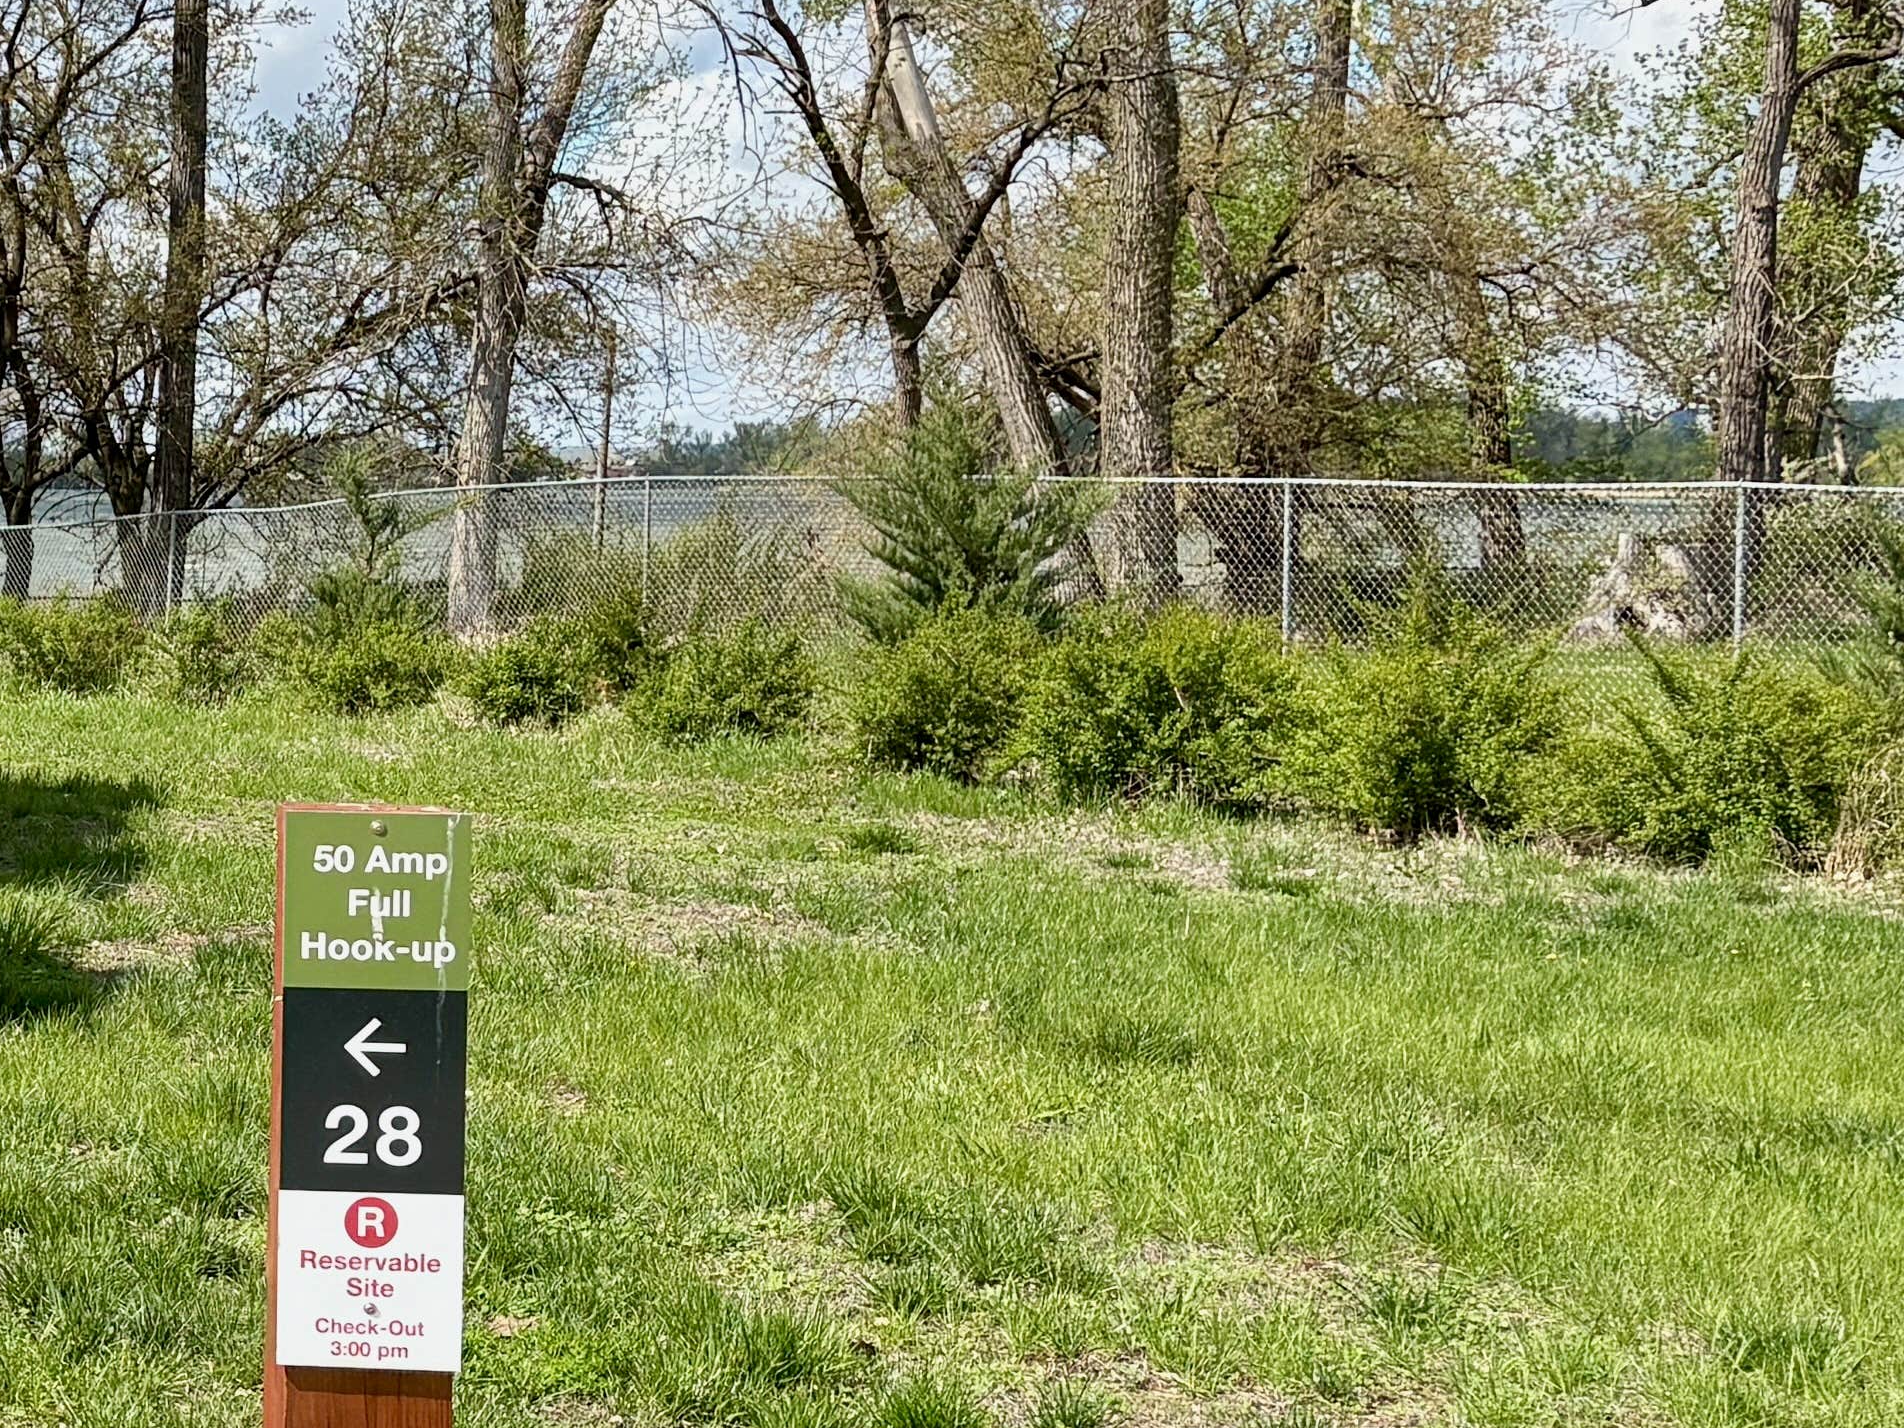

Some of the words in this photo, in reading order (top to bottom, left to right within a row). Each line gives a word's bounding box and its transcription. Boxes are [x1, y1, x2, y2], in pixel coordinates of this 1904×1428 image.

[313, 844, 355, 873] 50
[364, 844, 448, 880] Amp
[348, 888, 411, 917] Full
[301, 931, 456, 968] Hook-up
[323, 1104, 422, 1167] 28
[357, 1206, 385, 1238] R
[300, 1250, 441, 1273] Reservable
[346, 1277, 394, 1297] Site
[315, 1317, 424, 1337] Check-Out
[330, 1340, 371, 1357] 3:00
[378, 1345, 408, 1361] pm
